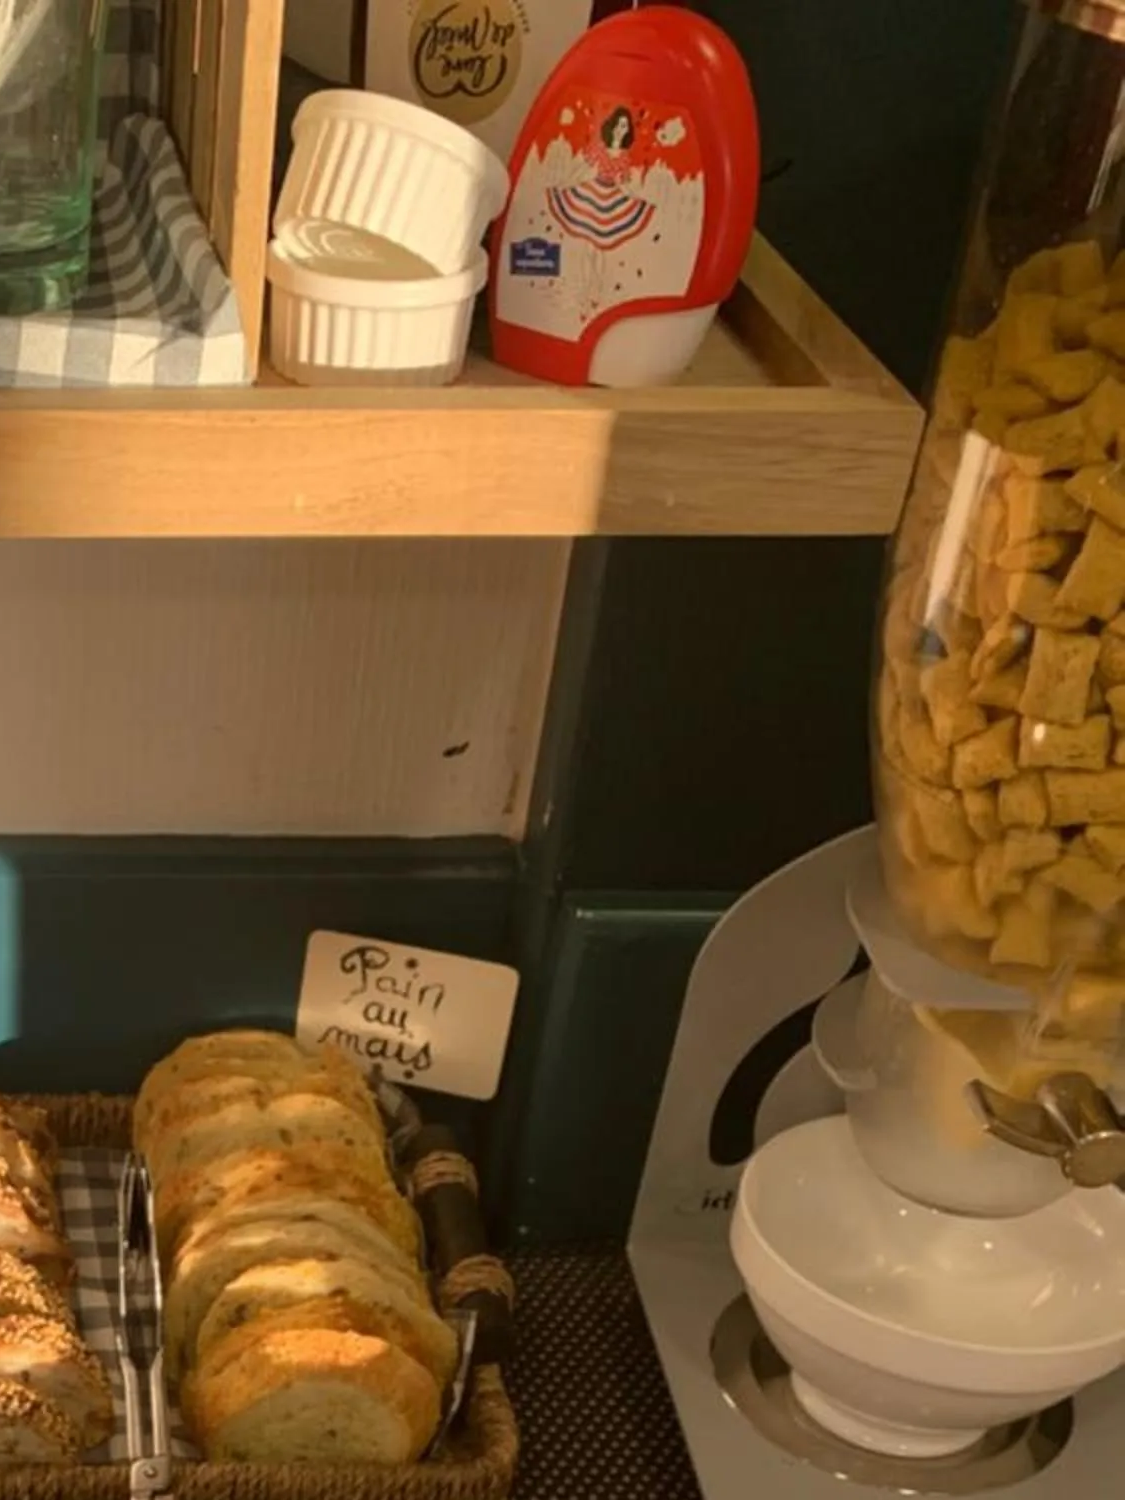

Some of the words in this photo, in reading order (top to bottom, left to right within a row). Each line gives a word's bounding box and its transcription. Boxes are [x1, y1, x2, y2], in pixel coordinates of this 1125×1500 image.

[492, 21, 516, 47] de
[340, 946, 445, 1014] Pain
[363, 1000, 408, 1031] au
